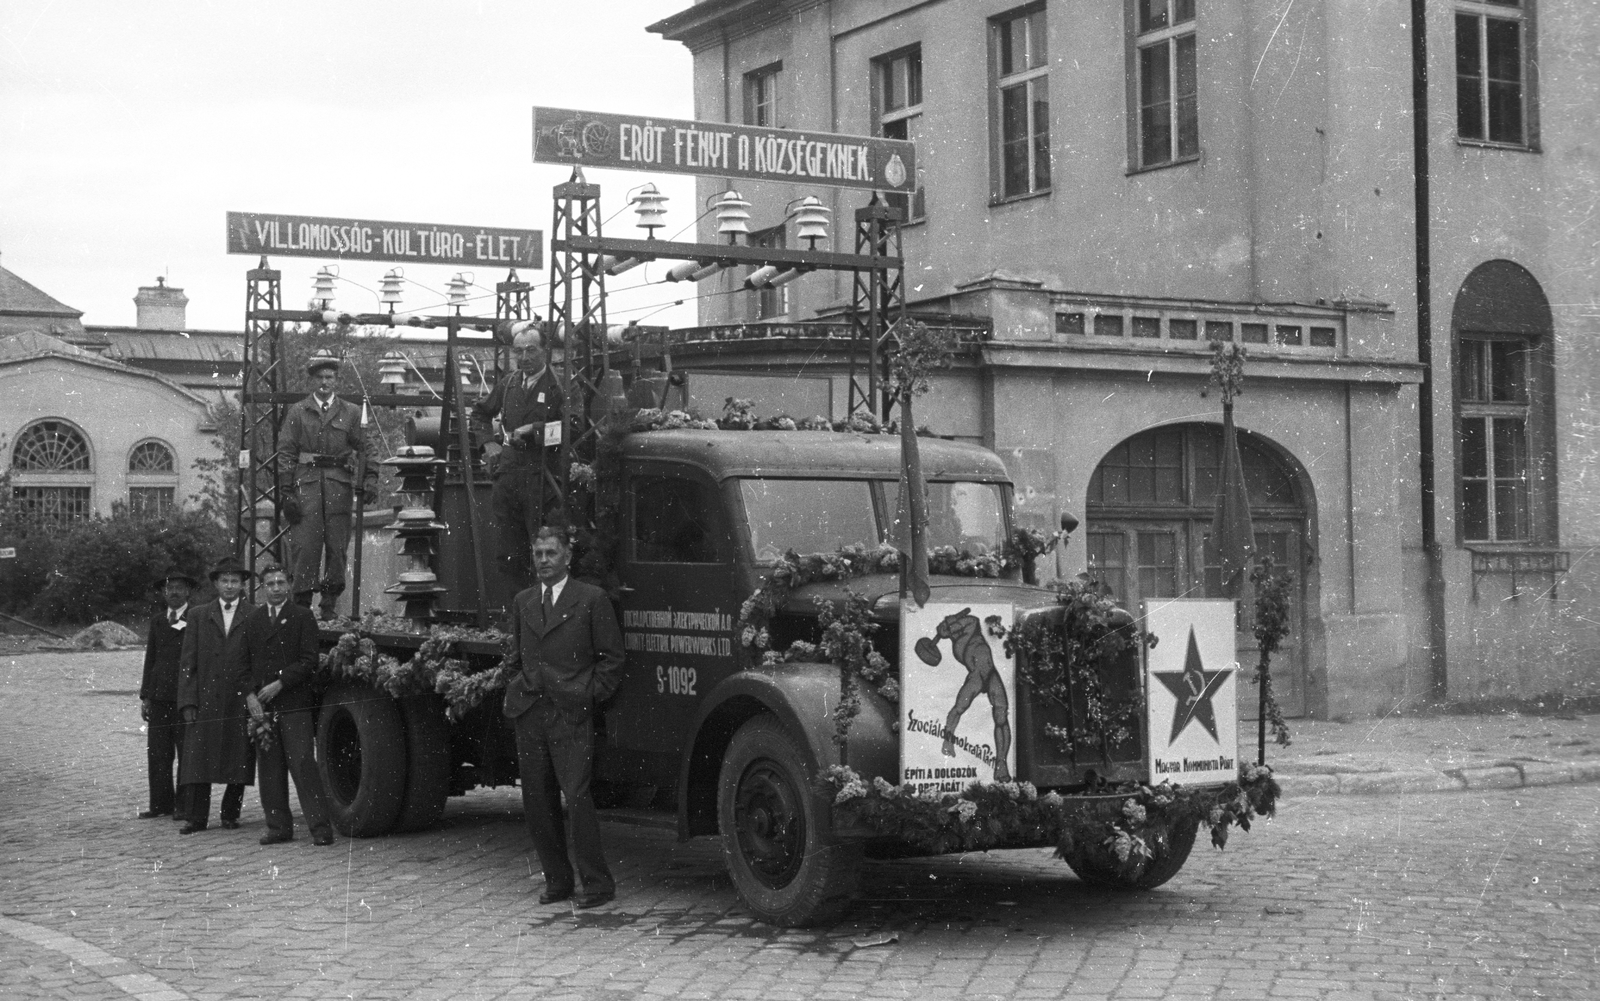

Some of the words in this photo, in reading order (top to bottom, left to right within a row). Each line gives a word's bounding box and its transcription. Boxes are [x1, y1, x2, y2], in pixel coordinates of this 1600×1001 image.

[674, 124, 732, 168] FÉNYT
[738, 134, 749, 171] A
[754, 133, 874, 182] KÖZSÉGEKNEK.
[656, 665, 697, 696] S-1092
[904, 766, 926, 780] ÉPÍTI
[926, 768, 933, 780] A
[934, 765, 977, 779] DOLGOZÓK
